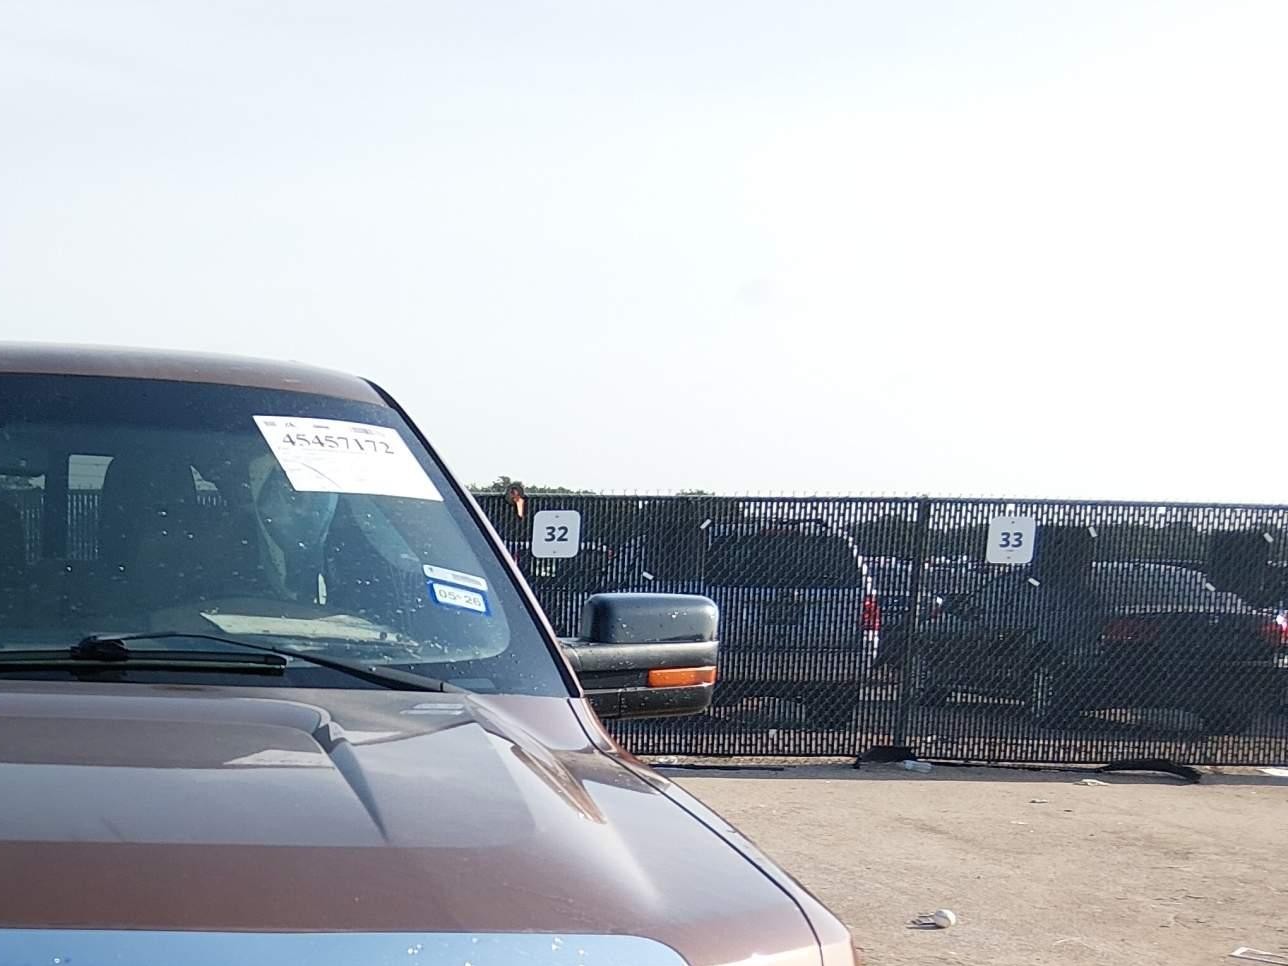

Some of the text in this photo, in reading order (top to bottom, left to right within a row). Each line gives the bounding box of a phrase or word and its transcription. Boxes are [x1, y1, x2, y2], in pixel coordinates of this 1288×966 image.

[282, 433, 395, 455] 45457172
[544, 525, 569, 542] 32
[999, 531, 1024, 548] 33
